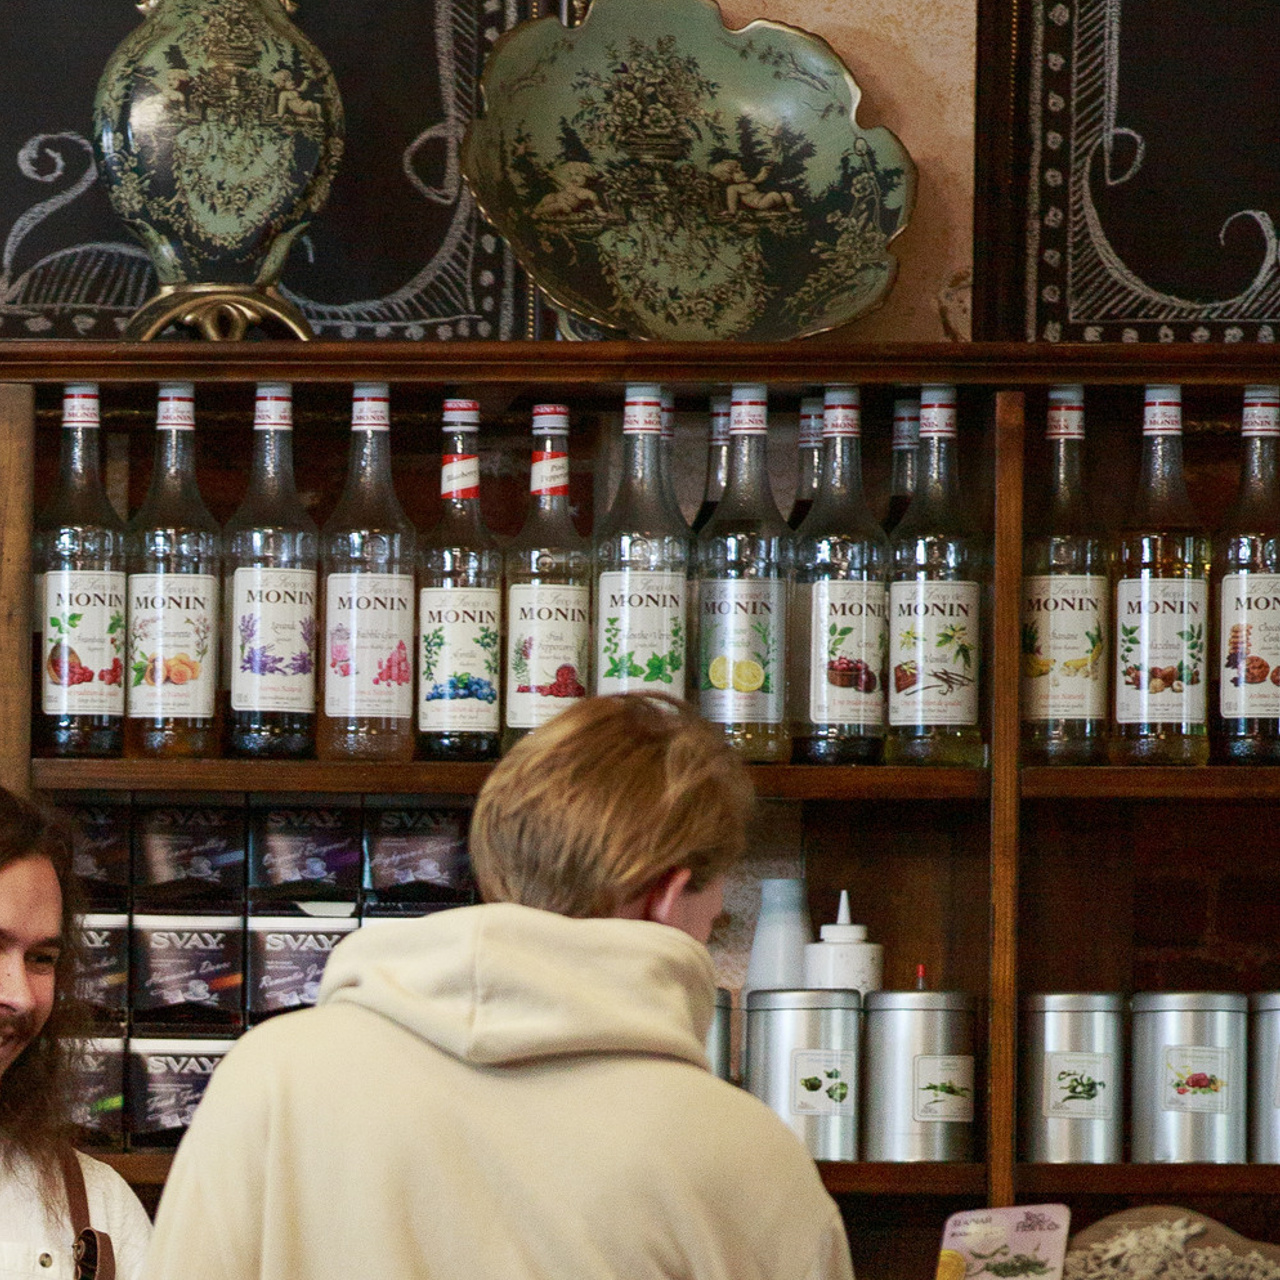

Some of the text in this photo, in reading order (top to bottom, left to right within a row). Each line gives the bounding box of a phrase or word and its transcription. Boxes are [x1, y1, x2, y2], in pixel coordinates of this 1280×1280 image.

[56, 592, 123, 607] MONIN
[134, 596, 206, 610] MONIN
[246, 589, 314, 605] MONIN
[337, 596, 408, 611] MONIN
[610, 593, 680, 608] MONIN
[1027, 597, 1099, 612] MONIN
[519, 607, 587, 622] MONIN
[703, 601, 773, 615] MONIN
[898, 603, 970, 617] MONIN
[1127, 600, 1199, 614] MONIN
[427, 610, 497, 624] MONIN
